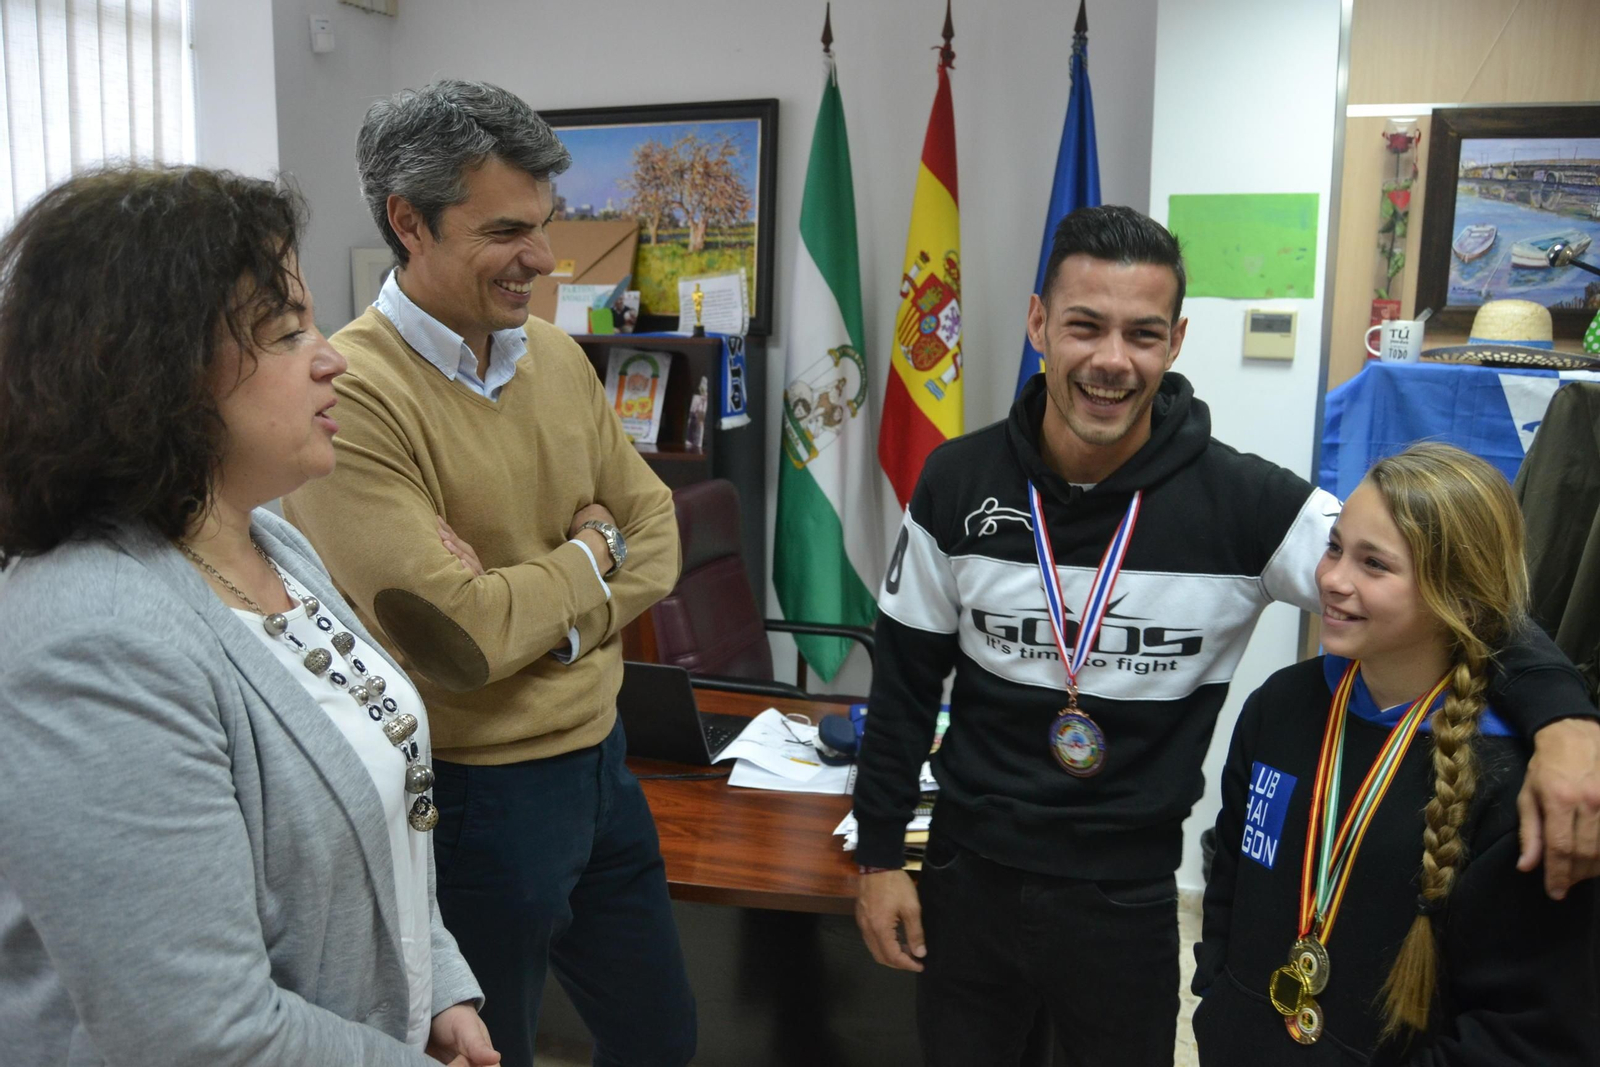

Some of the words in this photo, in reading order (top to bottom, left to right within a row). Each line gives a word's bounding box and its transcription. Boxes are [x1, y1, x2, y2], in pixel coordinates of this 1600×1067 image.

[1389, 348, 1408, 359] TODO
[986, 635, 1011, 653] It's
[1117, 658, 1177, 675] fight
[1241, 824, 1278, 866] GON
